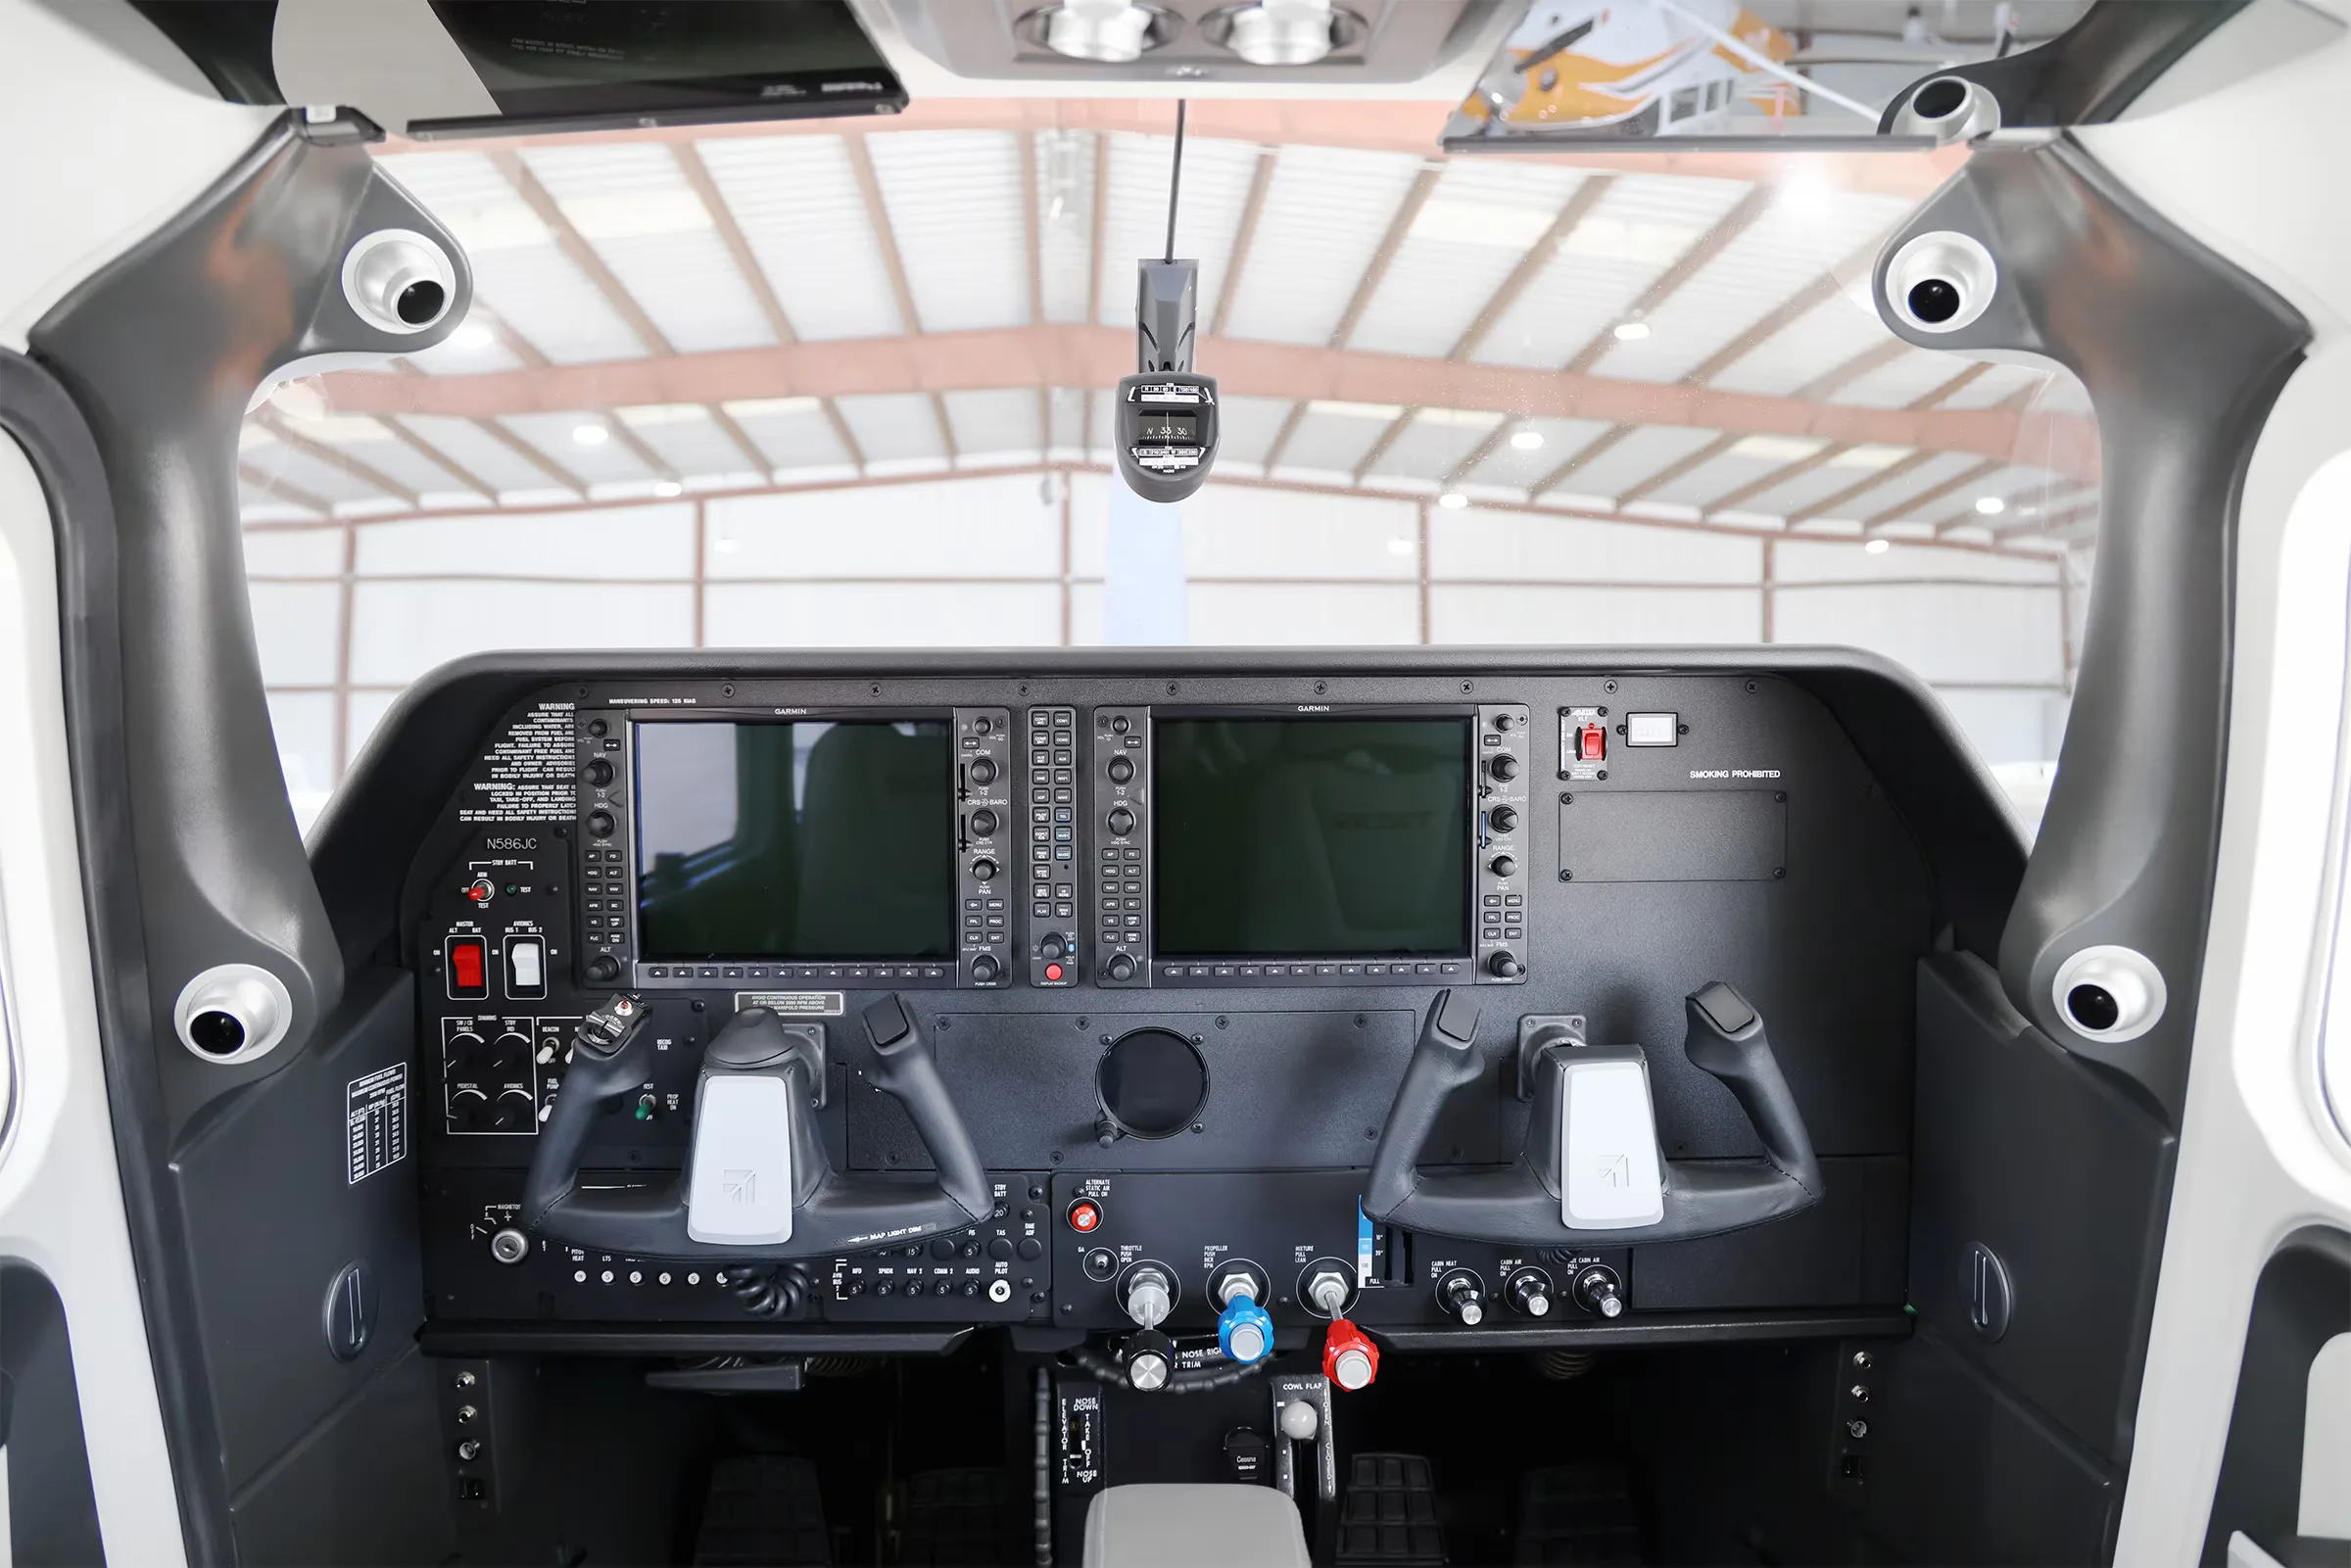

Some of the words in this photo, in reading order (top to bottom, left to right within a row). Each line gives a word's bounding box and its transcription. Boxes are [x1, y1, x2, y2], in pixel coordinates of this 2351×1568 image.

[487, 838, 537, 849] N586JC
[888, 1228, 906, 1237] LIGHT
[1181, 1350, 1203, 1358] NOSE
